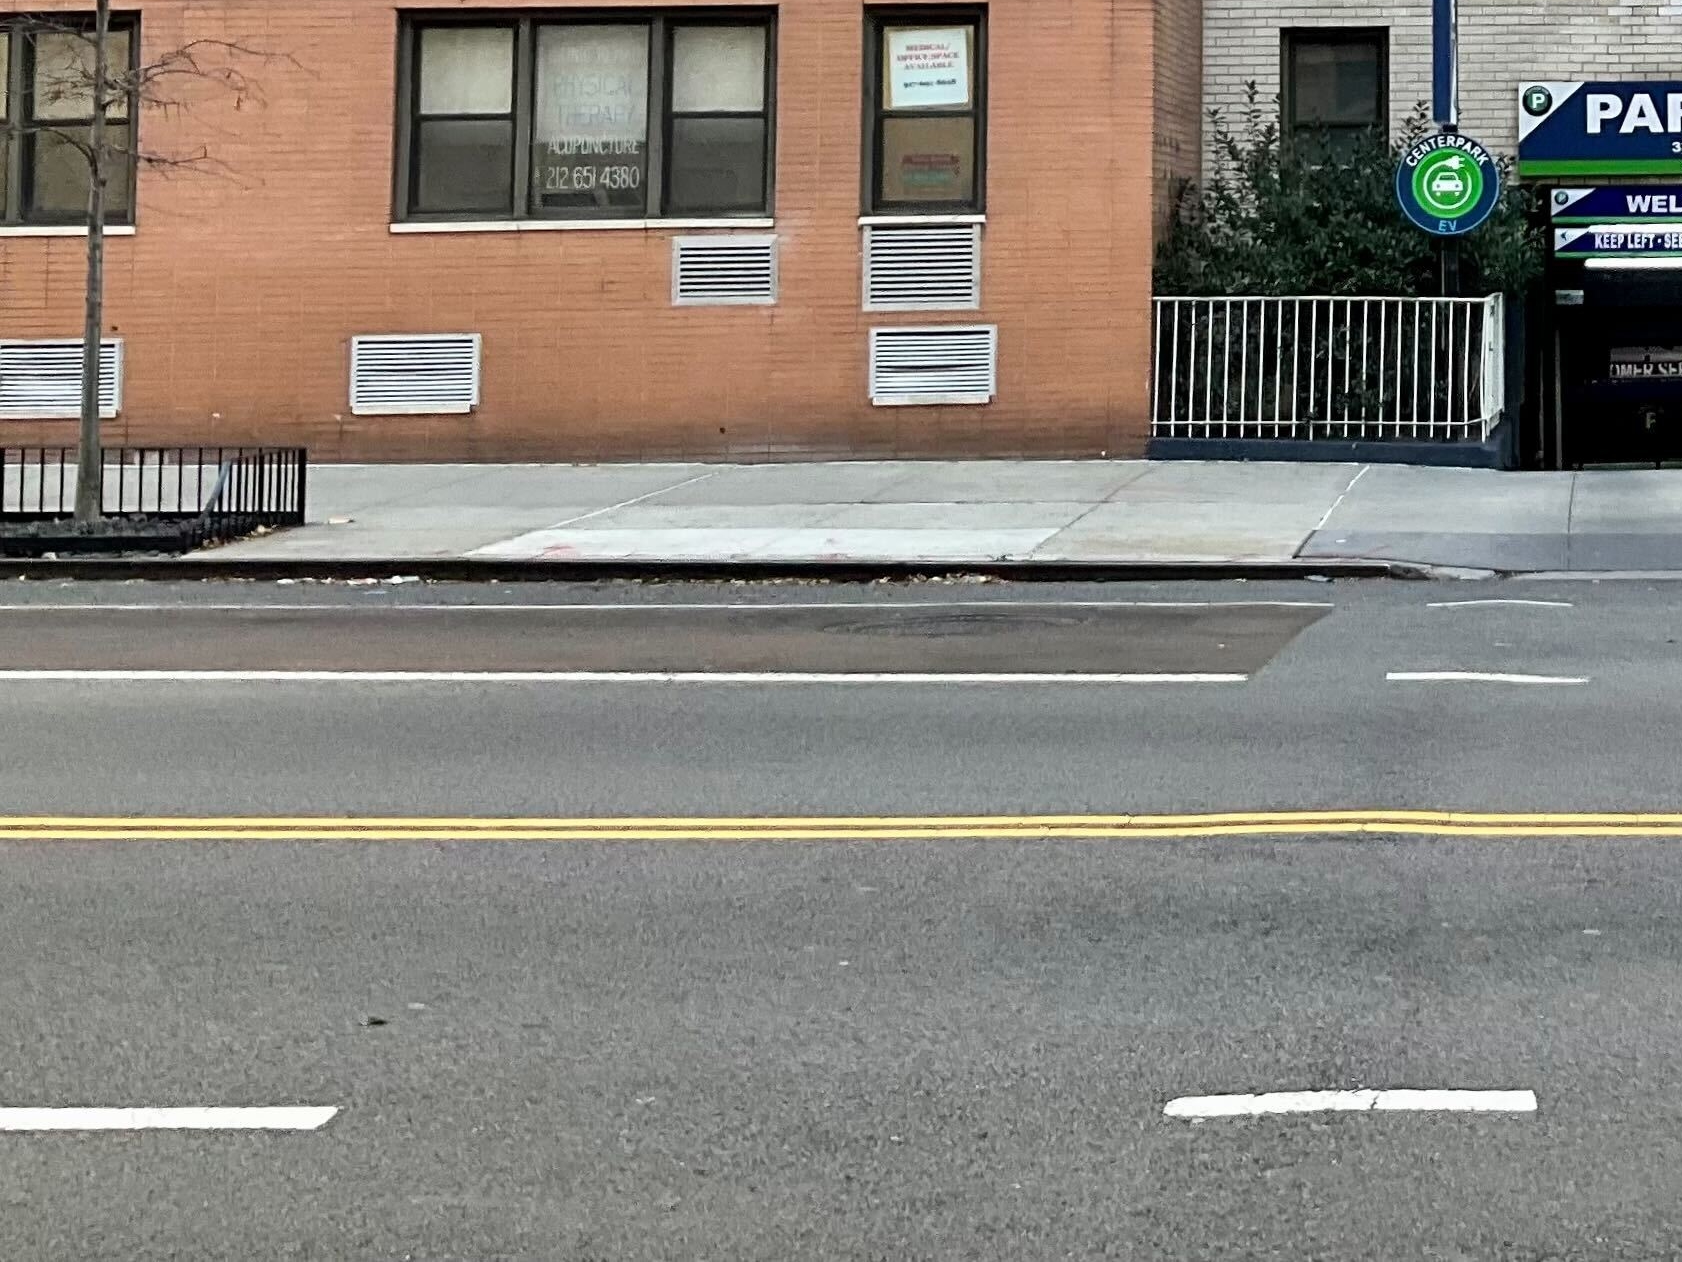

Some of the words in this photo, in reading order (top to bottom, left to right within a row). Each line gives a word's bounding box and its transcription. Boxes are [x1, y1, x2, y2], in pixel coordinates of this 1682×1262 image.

[1405, 135, 1490, 167] CENTERPARK
[546, 166, 569, 189] 212
[600, 166, 640, 189] 4380
[1437, 219, 1457, 232] EV
[1595, 233, 1624, 249] KEEP
[1627, 233, 1656, 249] LEFT
